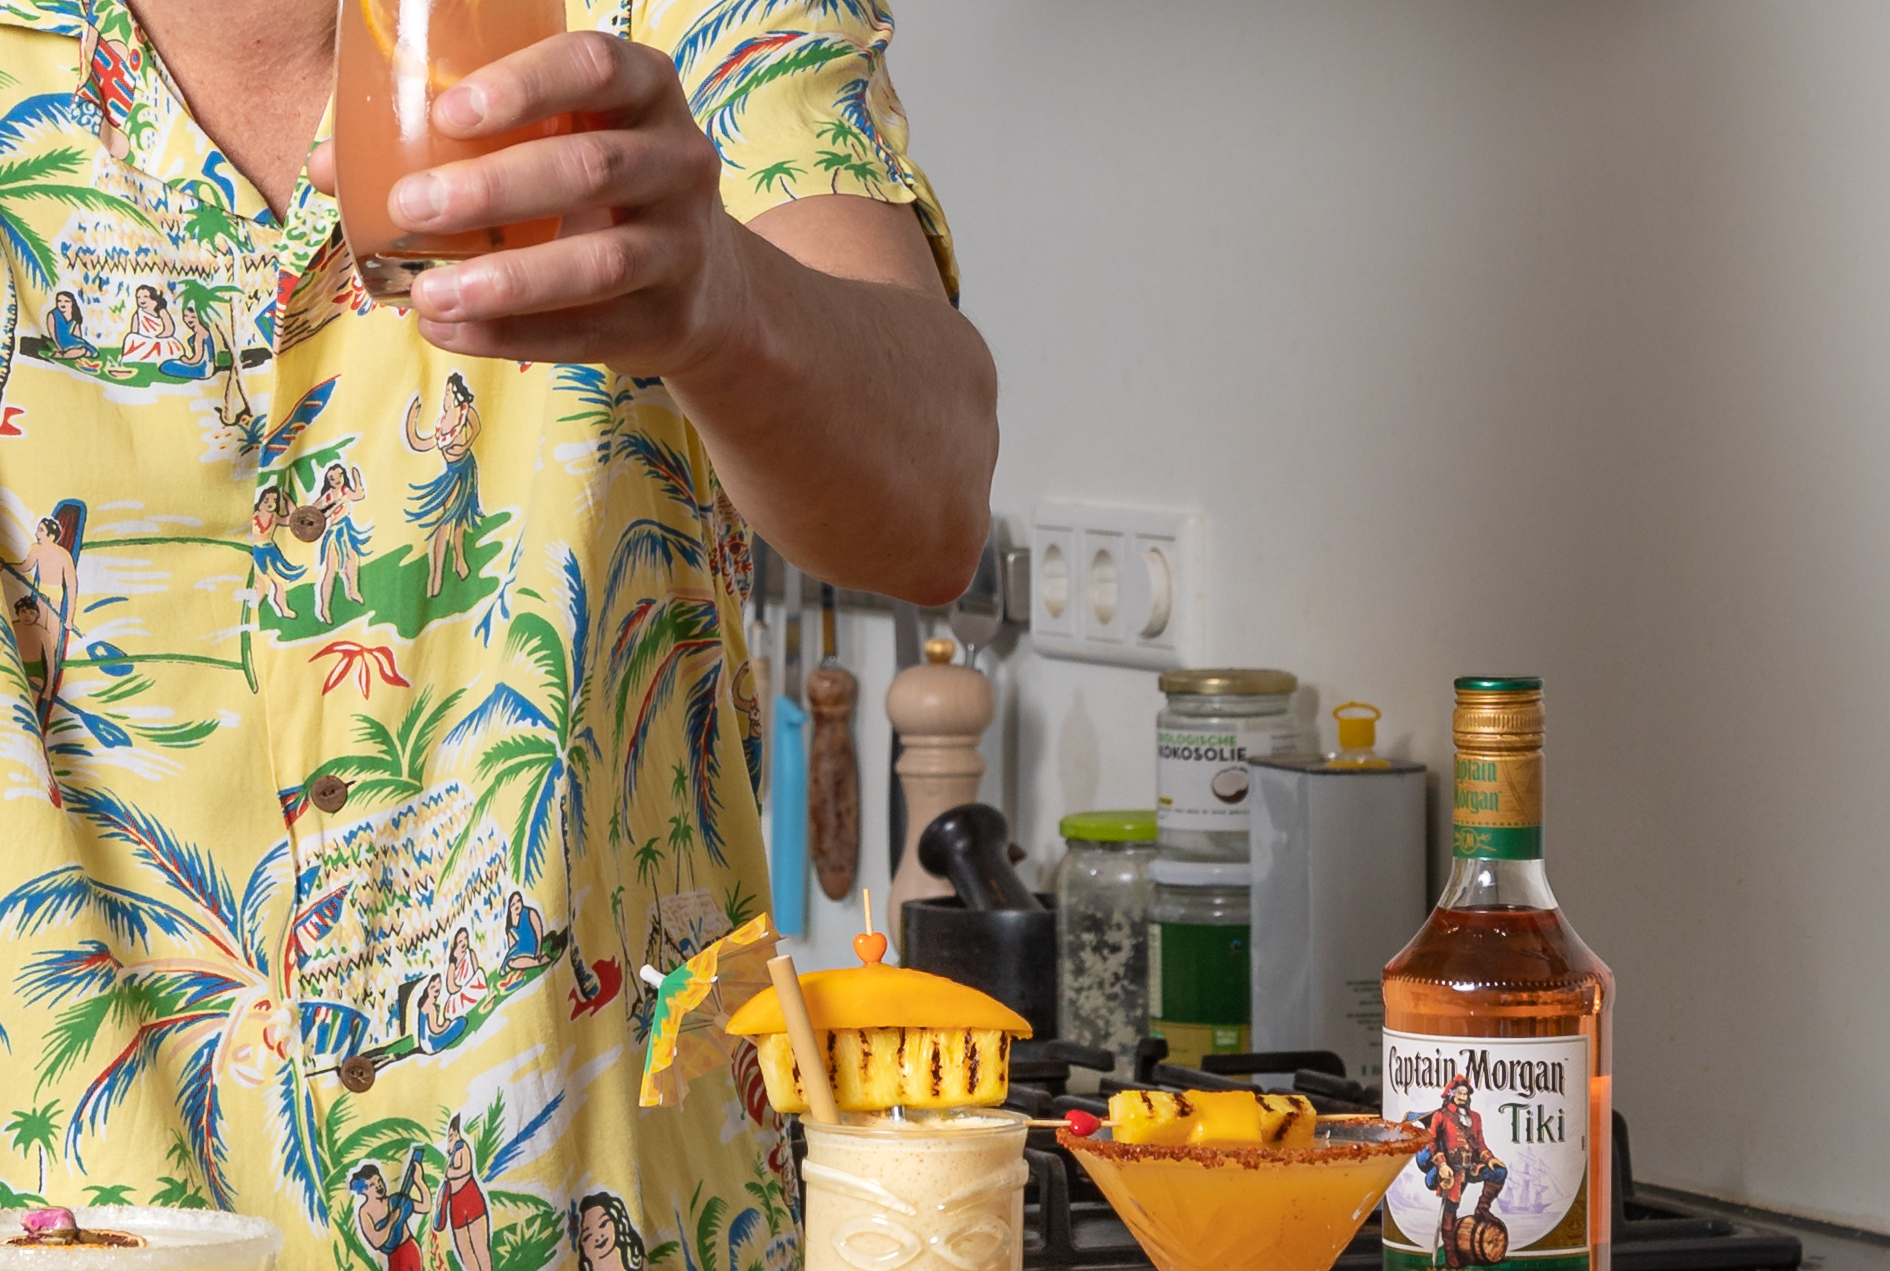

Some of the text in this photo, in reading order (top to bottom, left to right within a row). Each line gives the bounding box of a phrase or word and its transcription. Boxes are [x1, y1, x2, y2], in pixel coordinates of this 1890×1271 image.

[1389, 1045, 1566, 1099] Captain Morgan
[1498, 1102, 1566, 1144] Tiki
